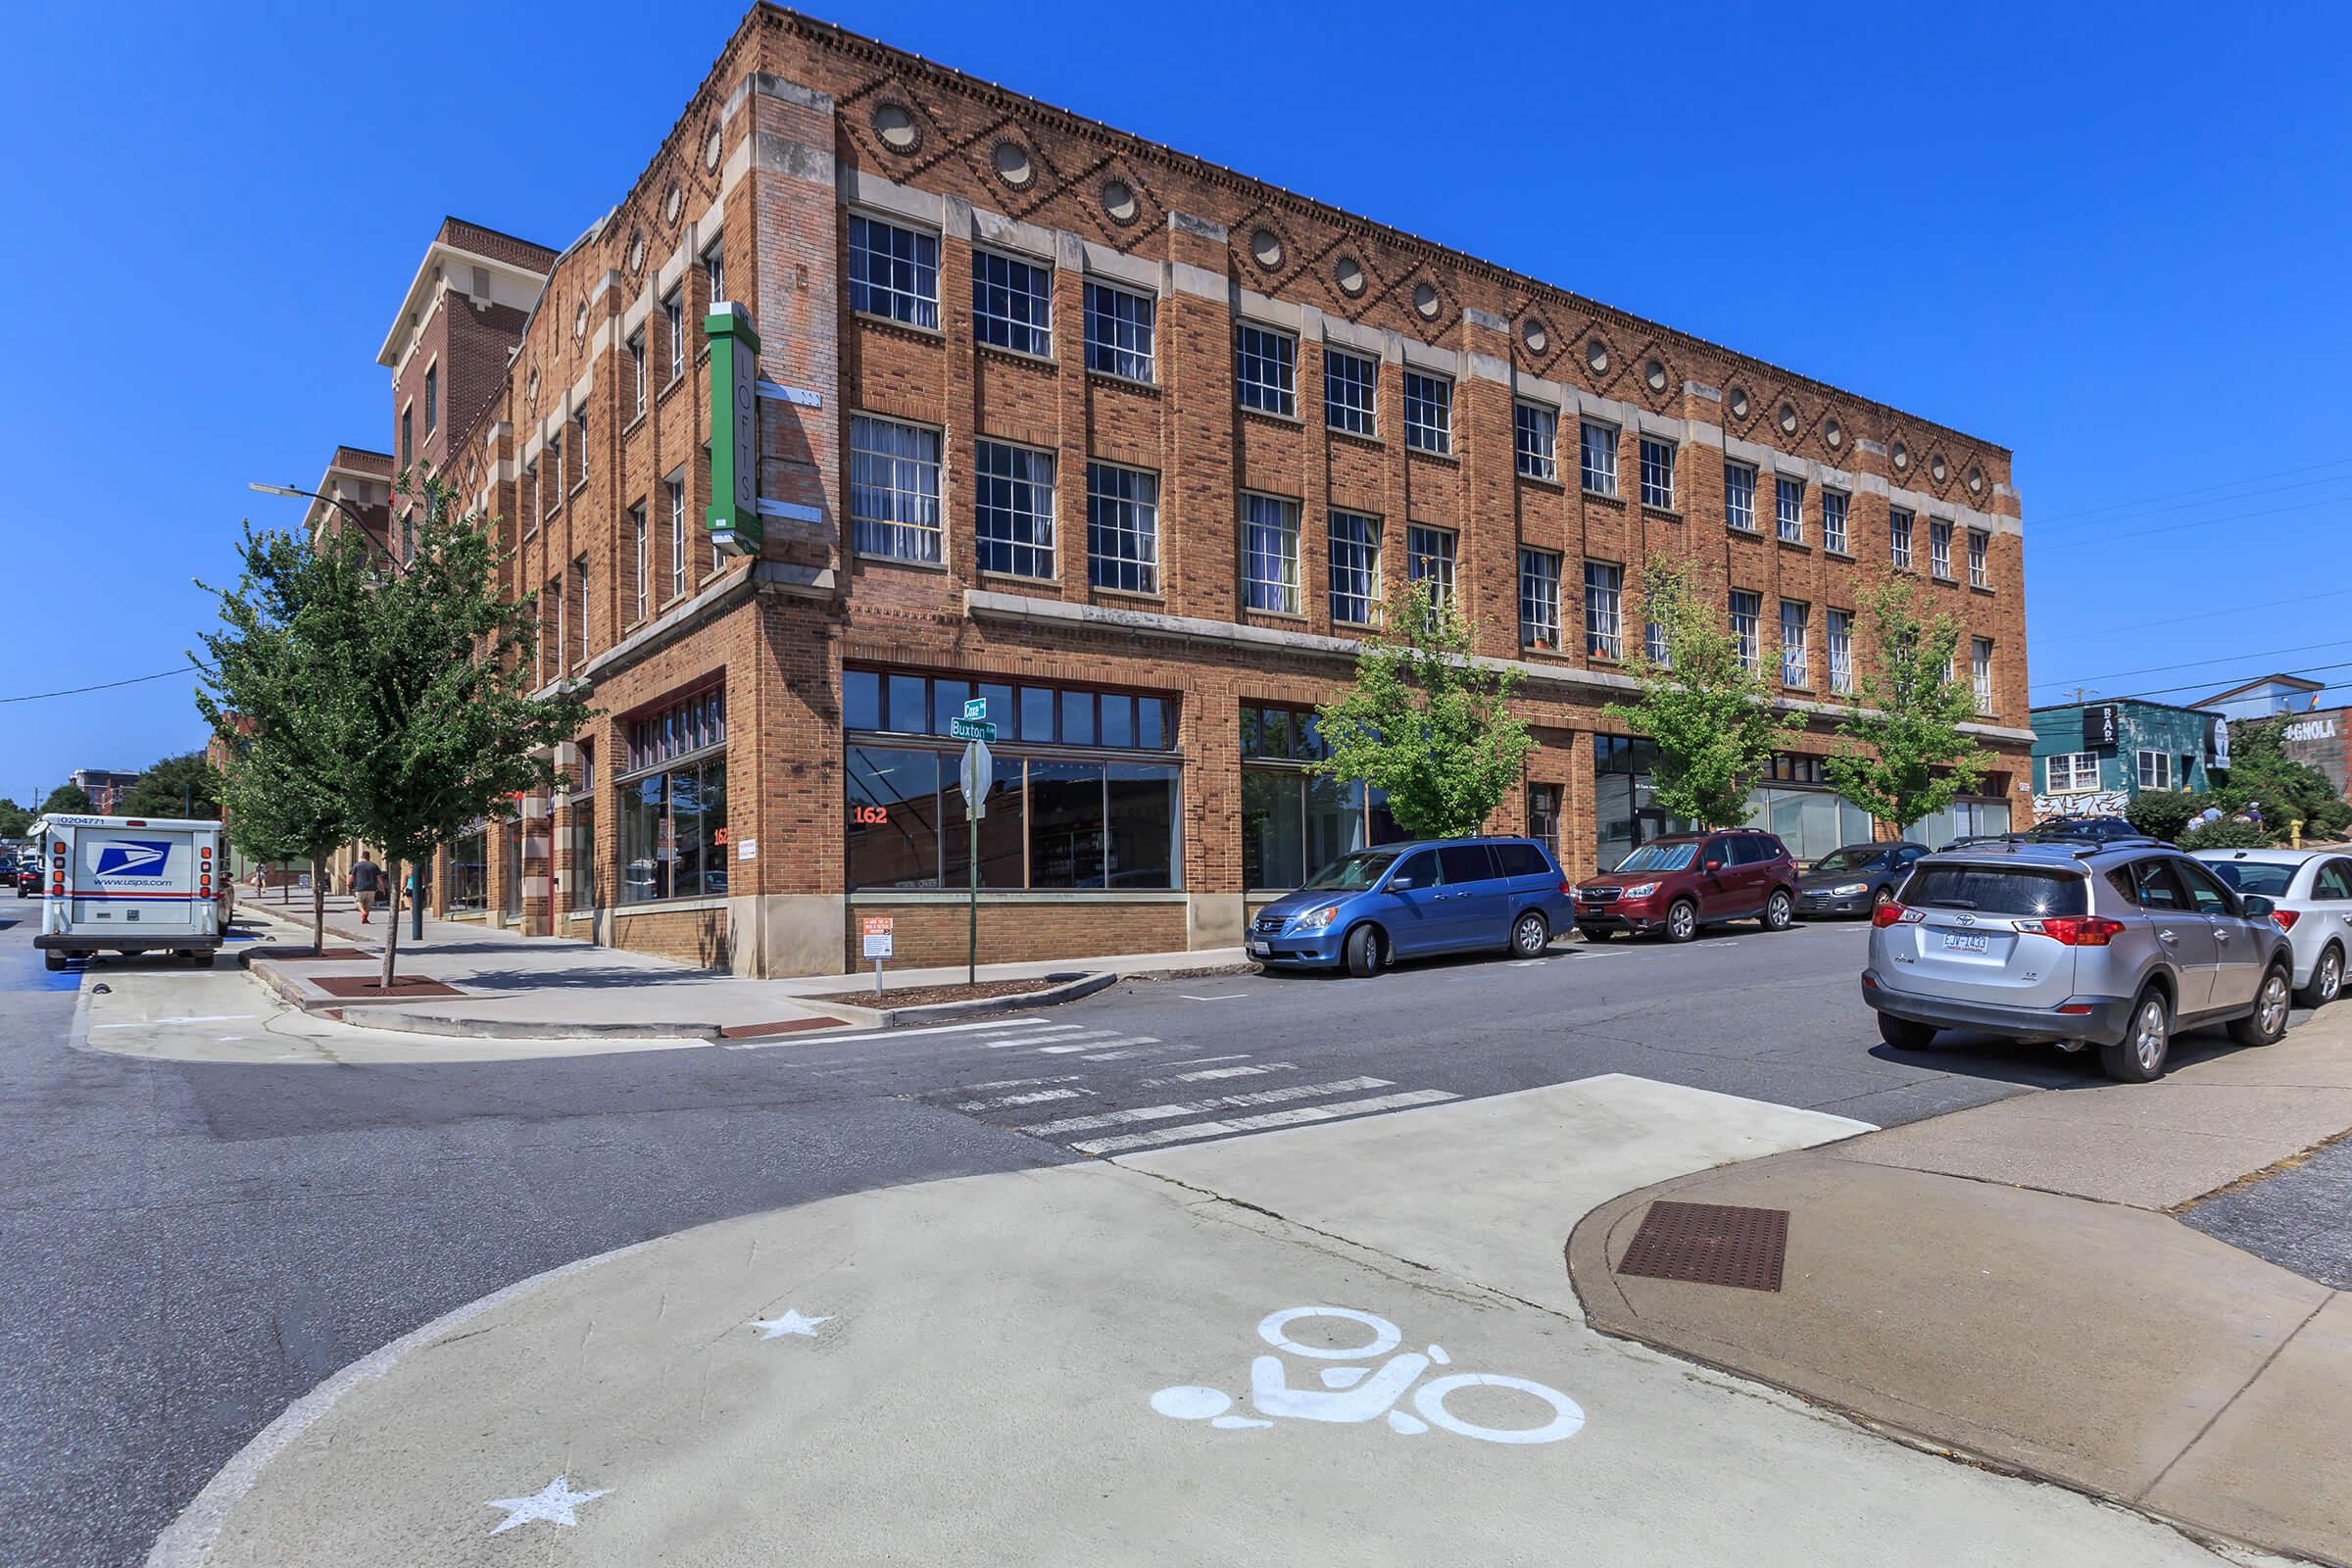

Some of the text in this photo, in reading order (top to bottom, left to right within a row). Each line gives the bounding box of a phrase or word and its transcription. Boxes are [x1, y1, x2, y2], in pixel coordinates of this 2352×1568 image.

[738, 353, 751, 501] LOFTS
[953, 720, 985, 738] Buxton
[2103, 708, 2114, 743] BAR
[61, 816, 105, 825] 0204771
[855, 807, 887, 823] 162
[94, 878, 172, 887] www.usps.com
